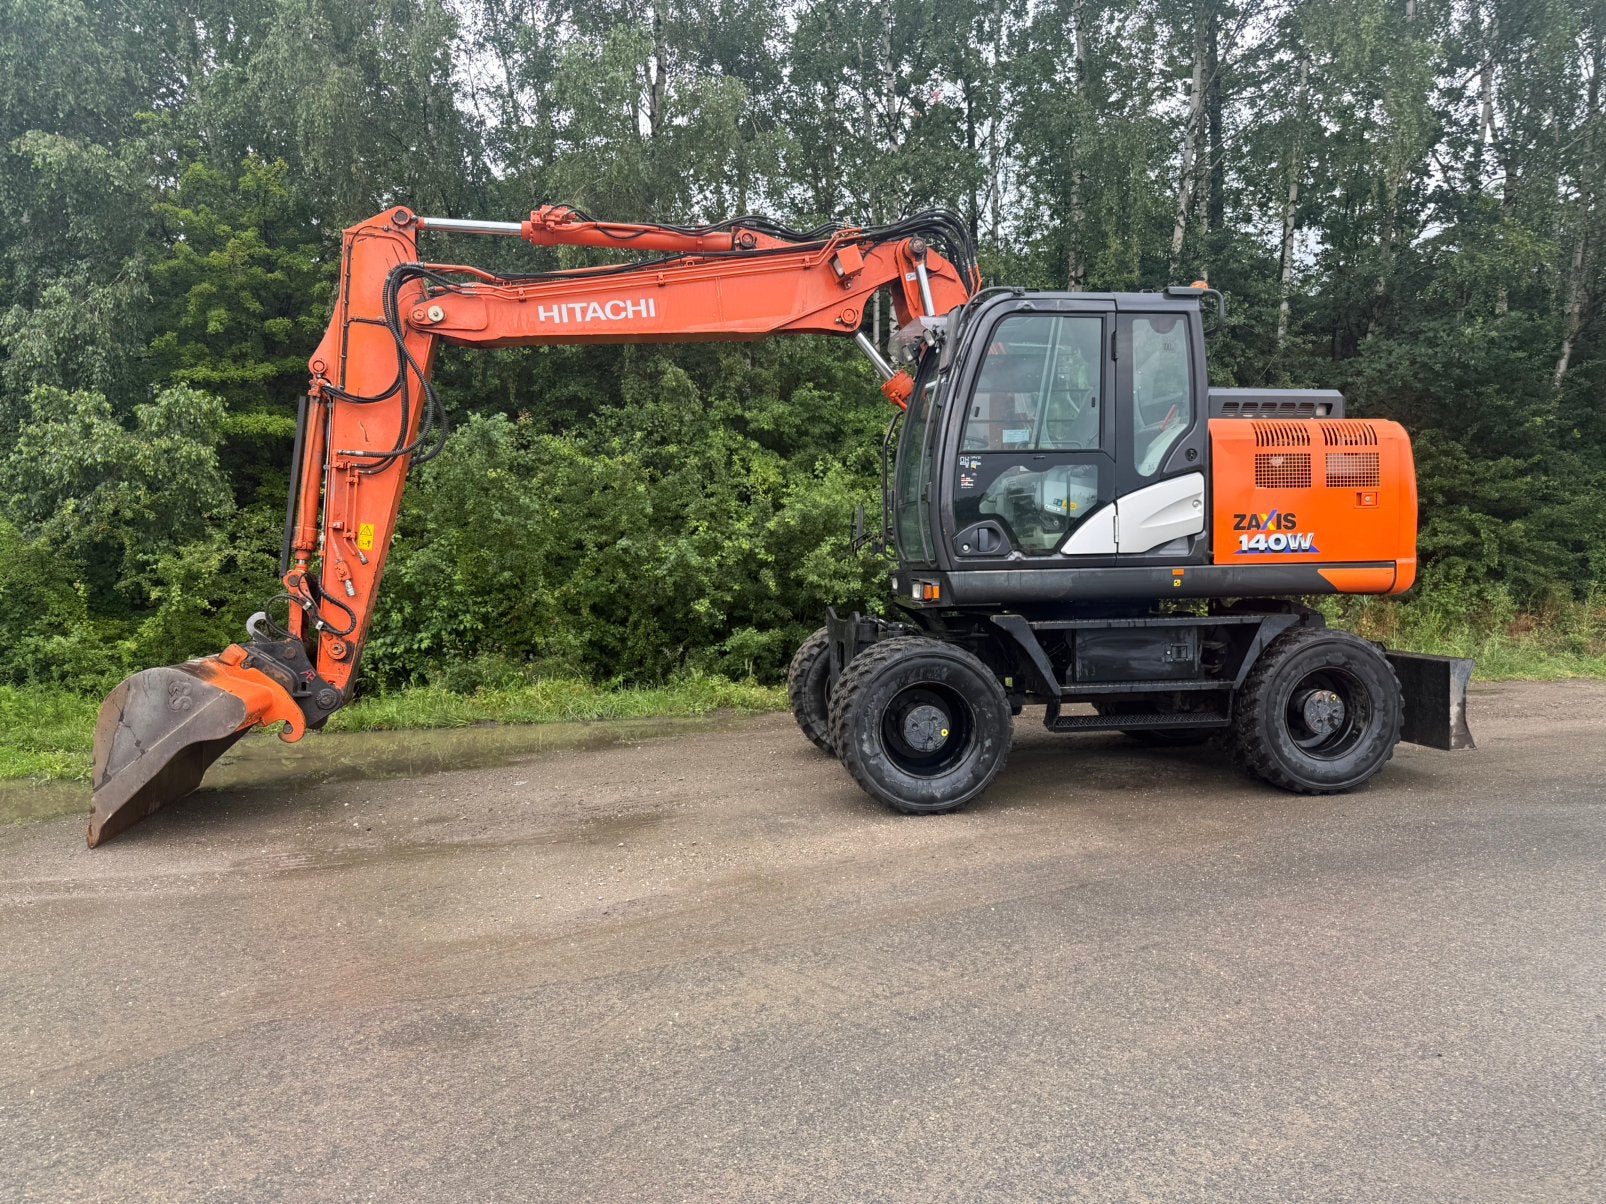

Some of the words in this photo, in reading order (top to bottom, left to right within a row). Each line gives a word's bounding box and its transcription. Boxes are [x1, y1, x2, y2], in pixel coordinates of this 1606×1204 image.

[537, 298, 656, 324] HITACHI
[1233, 509, 1297, 531] ZAXIS
[1239, 532, 1315, 553] 140W
